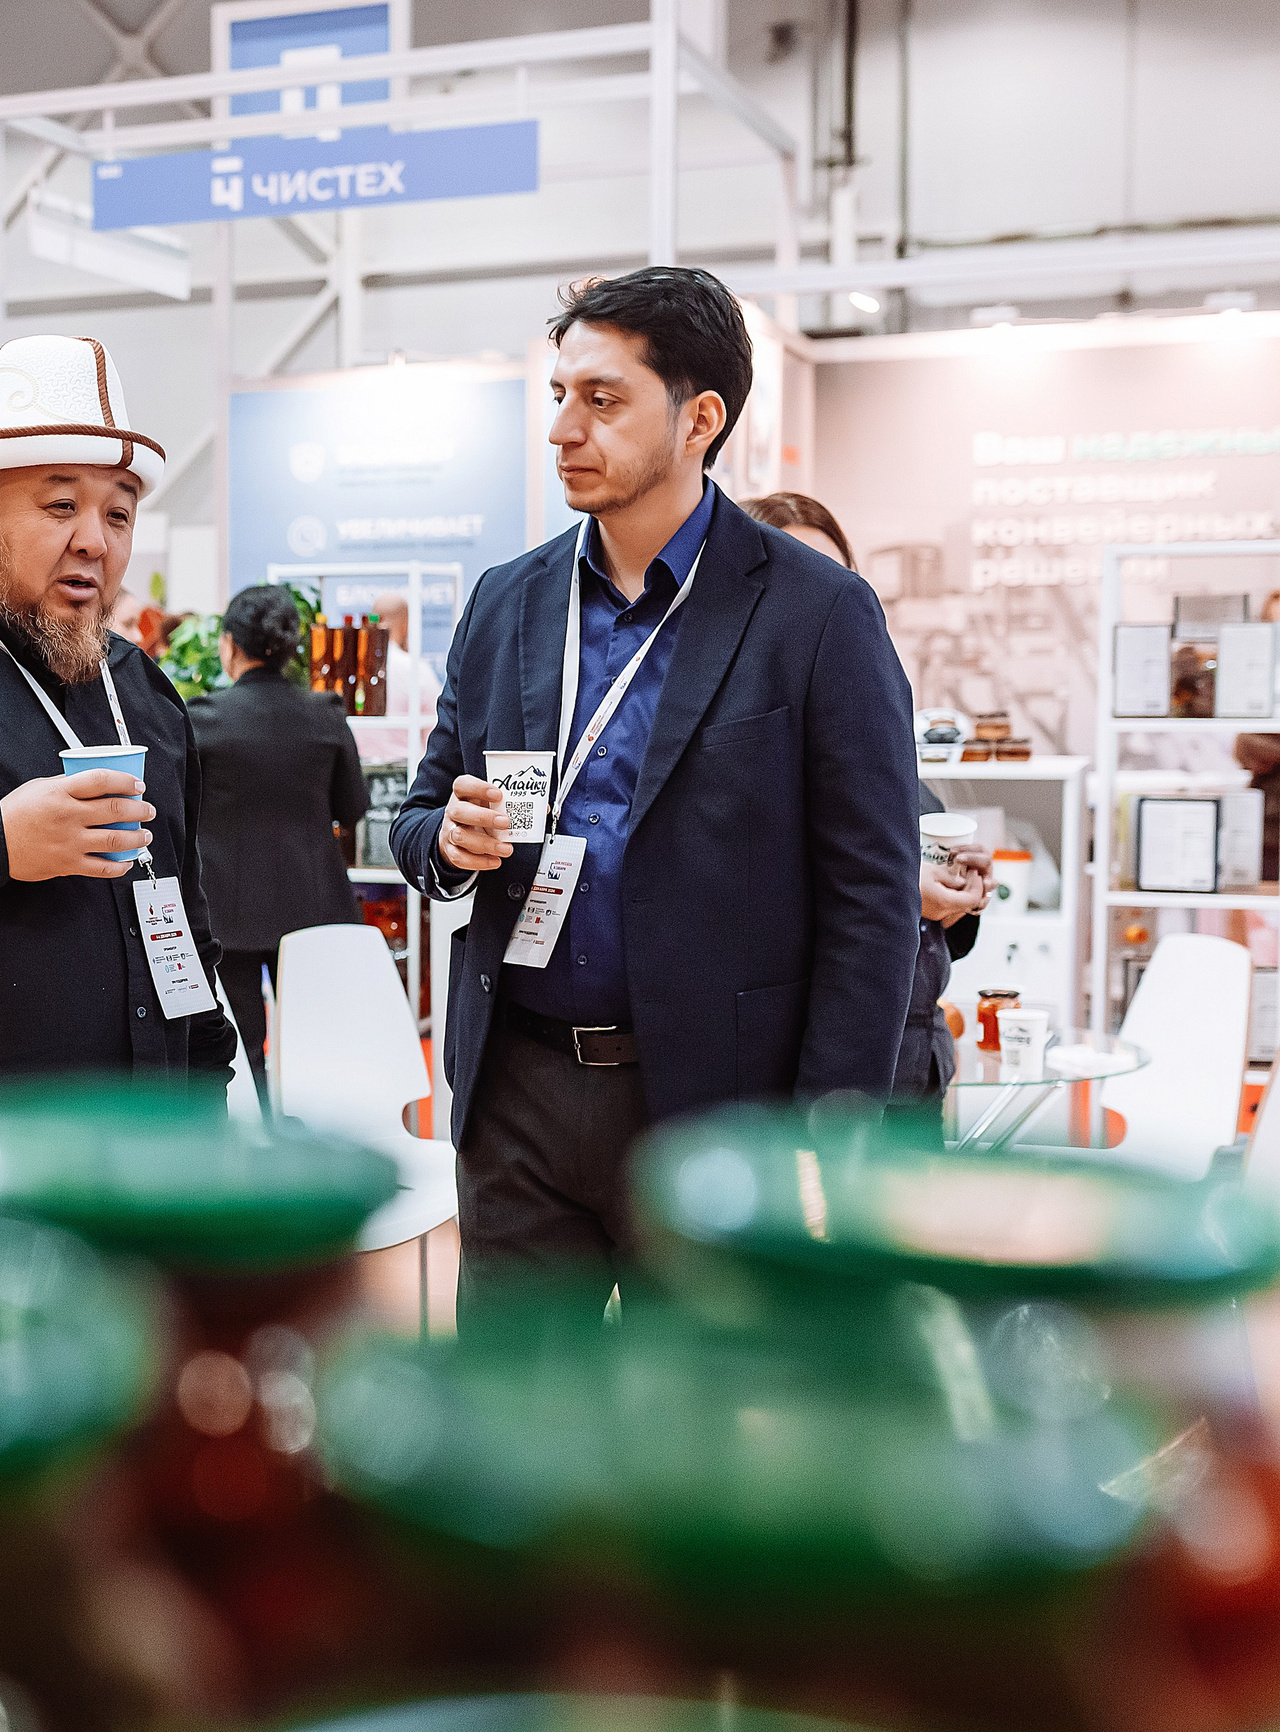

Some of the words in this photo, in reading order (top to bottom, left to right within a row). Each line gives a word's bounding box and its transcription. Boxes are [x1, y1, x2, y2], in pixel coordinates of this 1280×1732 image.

[251, 160, 406, 207] ЧИСТЕХ
[973, 431, 1065, 466] Ваш
[972, 471, 1216, 507] поставщик
[972, 507, 1277, 547] конвейерных
[492, 774, 547, 797] Алайку
